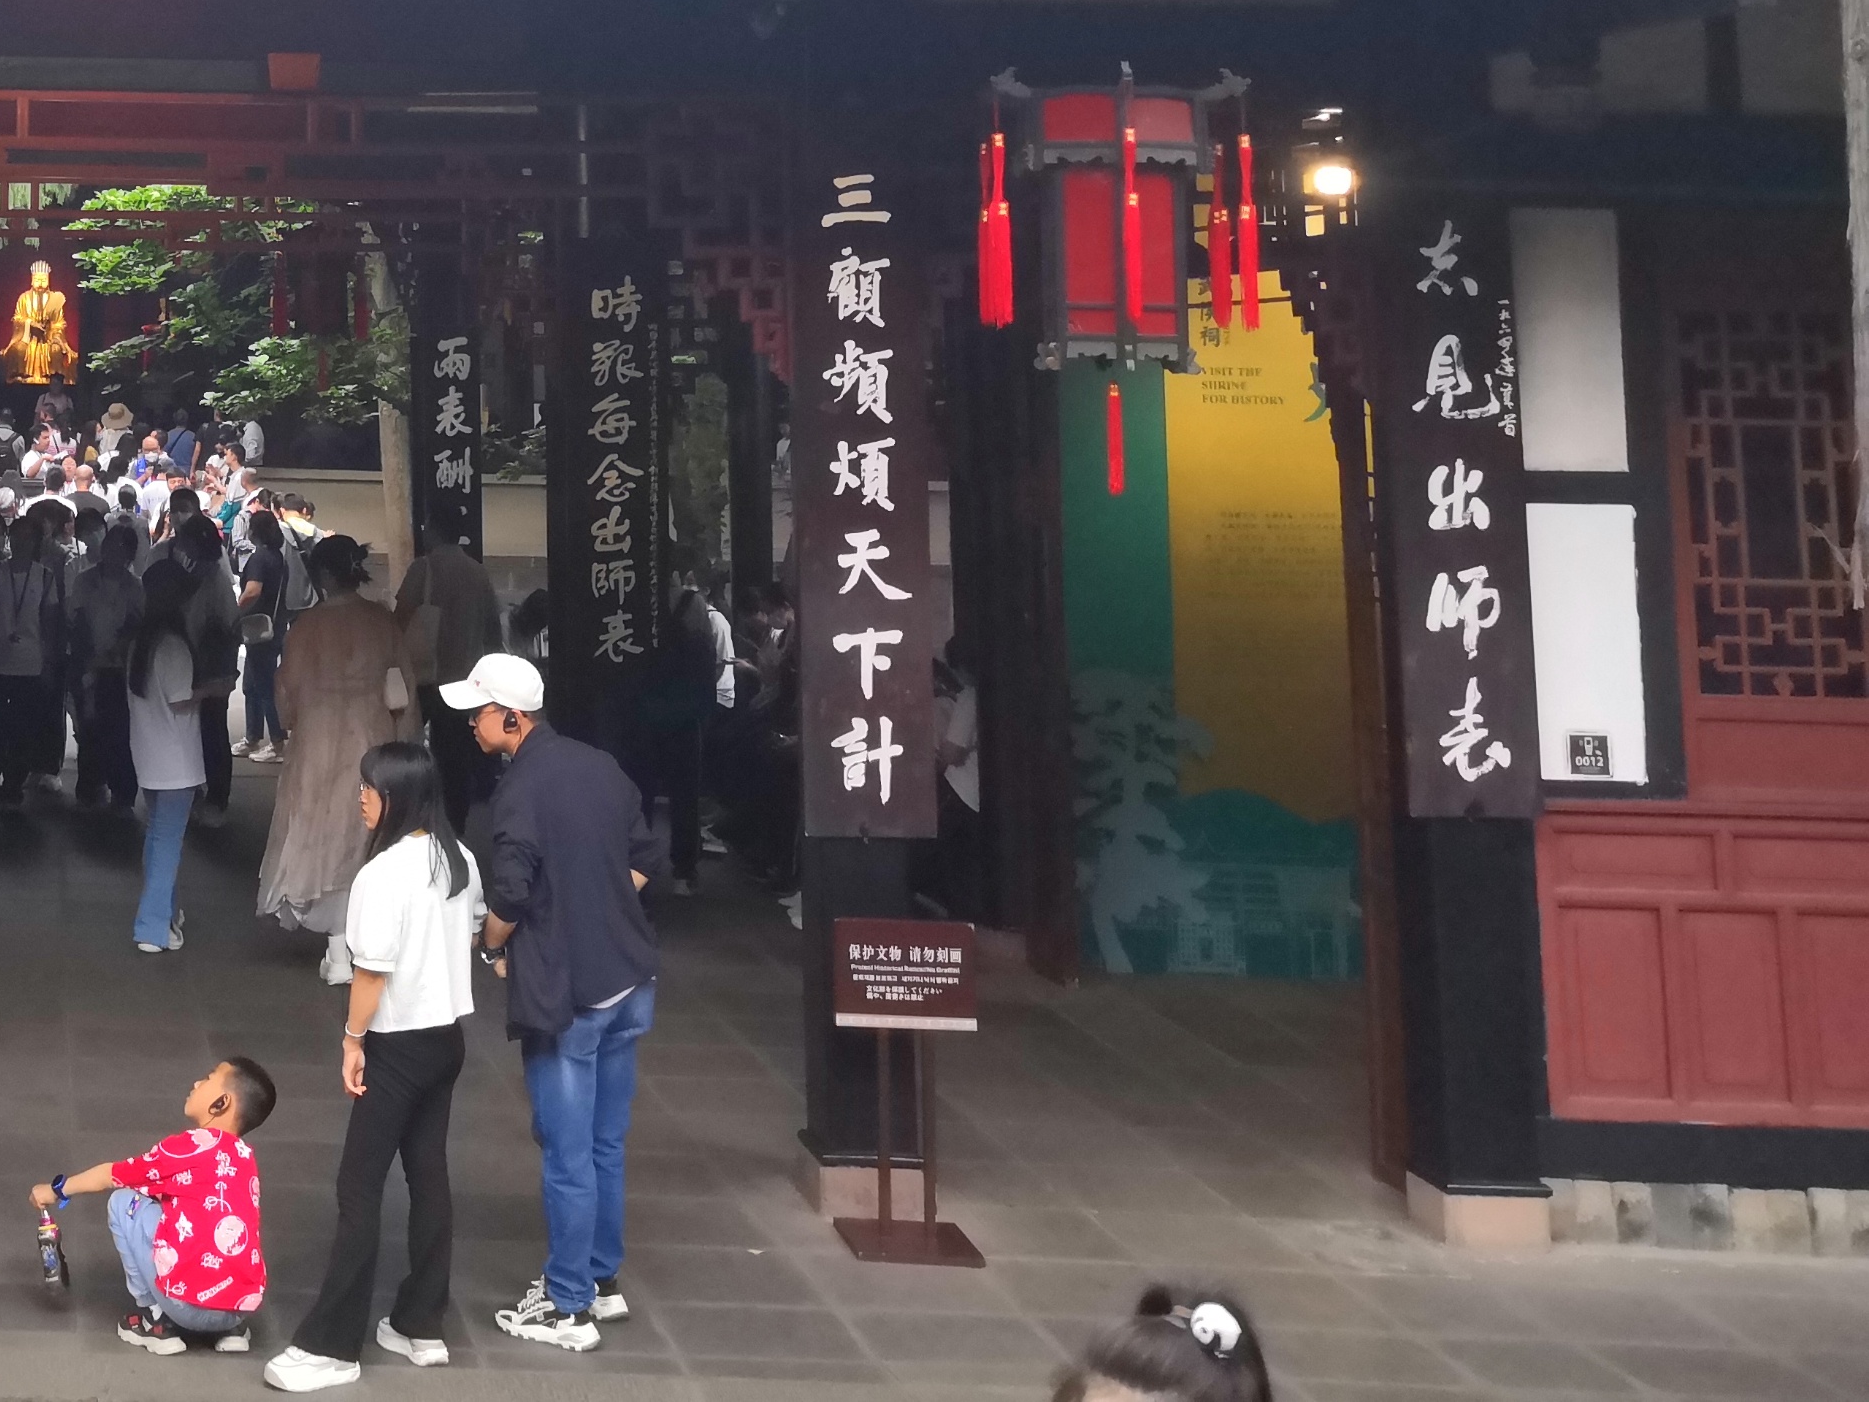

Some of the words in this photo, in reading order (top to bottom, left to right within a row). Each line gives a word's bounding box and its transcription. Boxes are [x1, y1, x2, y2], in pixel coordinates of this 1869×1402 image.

[1201, 394, 1228, 404] FOR
[1231, 395, 1286, 405] HISTORY
[1575, 756, 1604, 767] 0012
[848, 943, 902, 962] 保护文物
[908, 945, 962, 964] 请勿刻画
